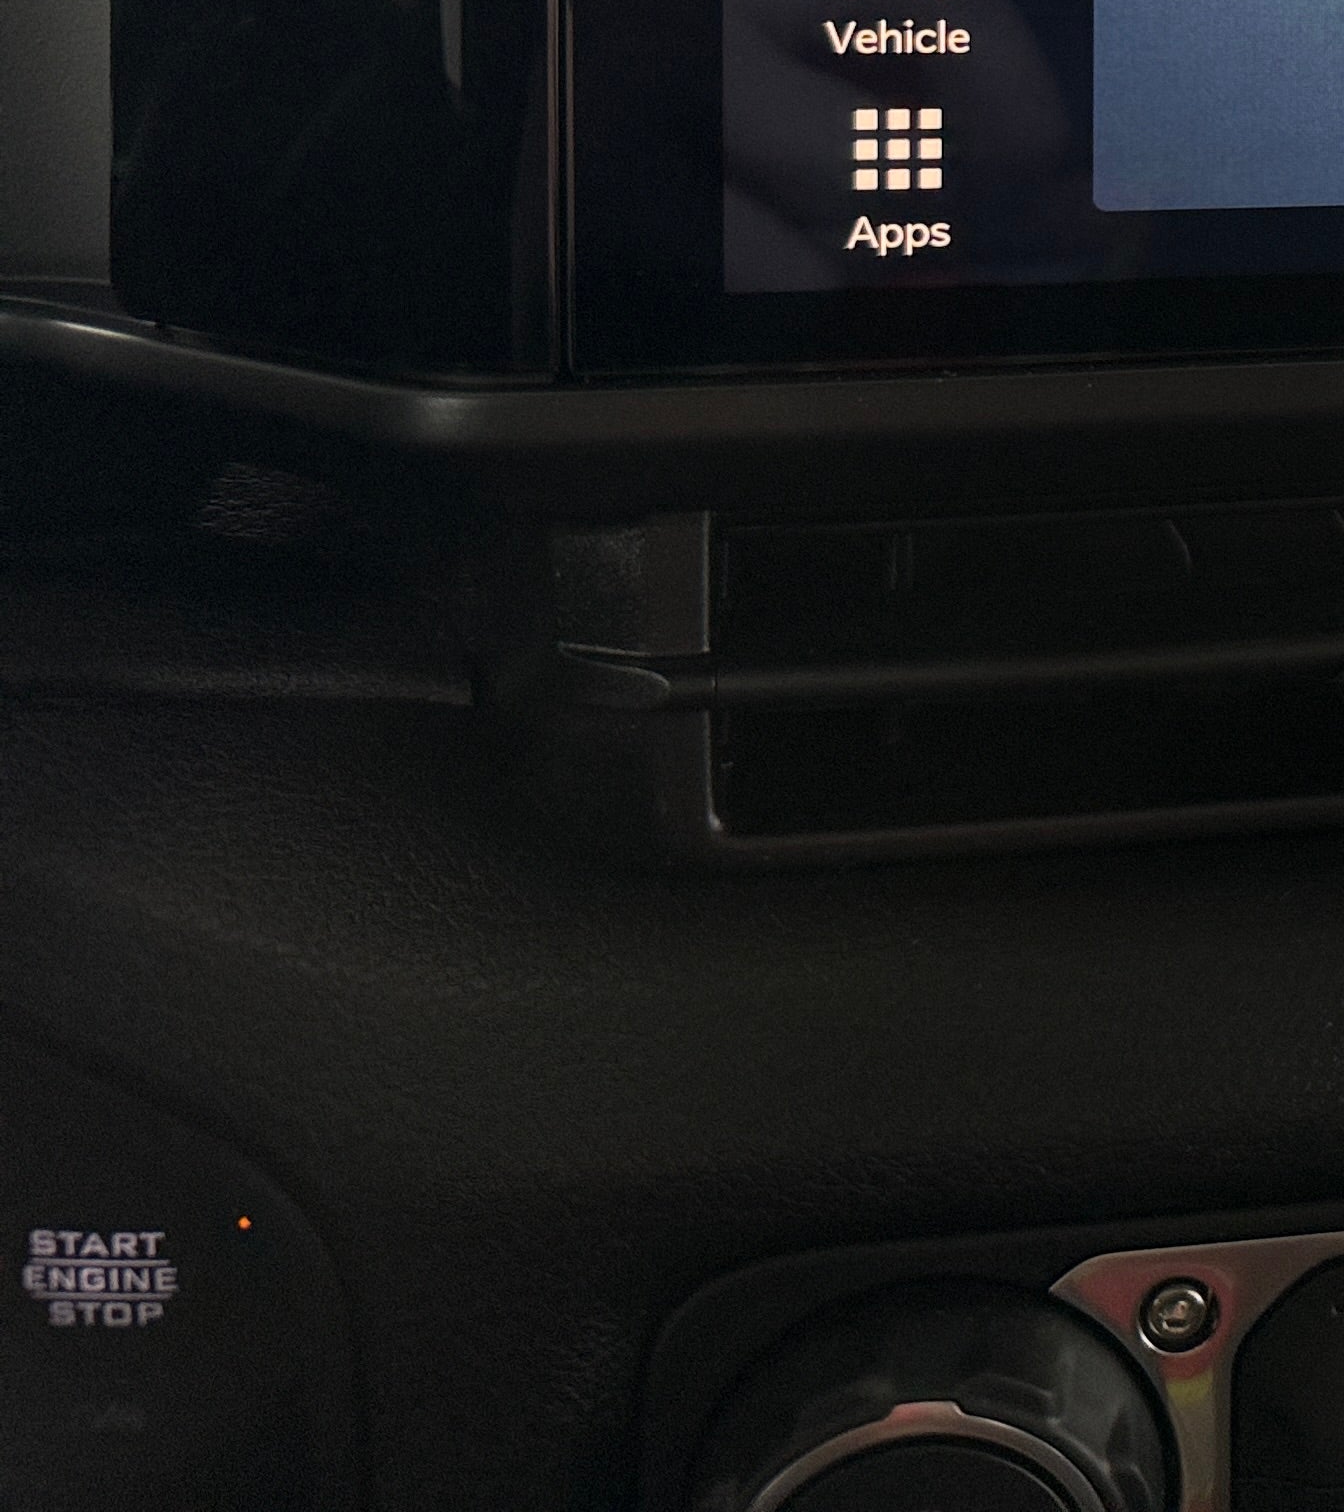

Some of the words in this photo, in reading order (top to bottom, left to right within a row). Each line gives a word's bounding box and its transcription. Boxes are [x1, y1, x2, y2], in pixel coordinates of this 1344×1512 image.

[824, 19, 972, 56] Vehicle
[843, 215, 952, 257] Apps
[28, 1228, 166, 1258] START
[22, 1265, 179, 1293] ENGINE
[48, 1300, 165, 1328] STOP
